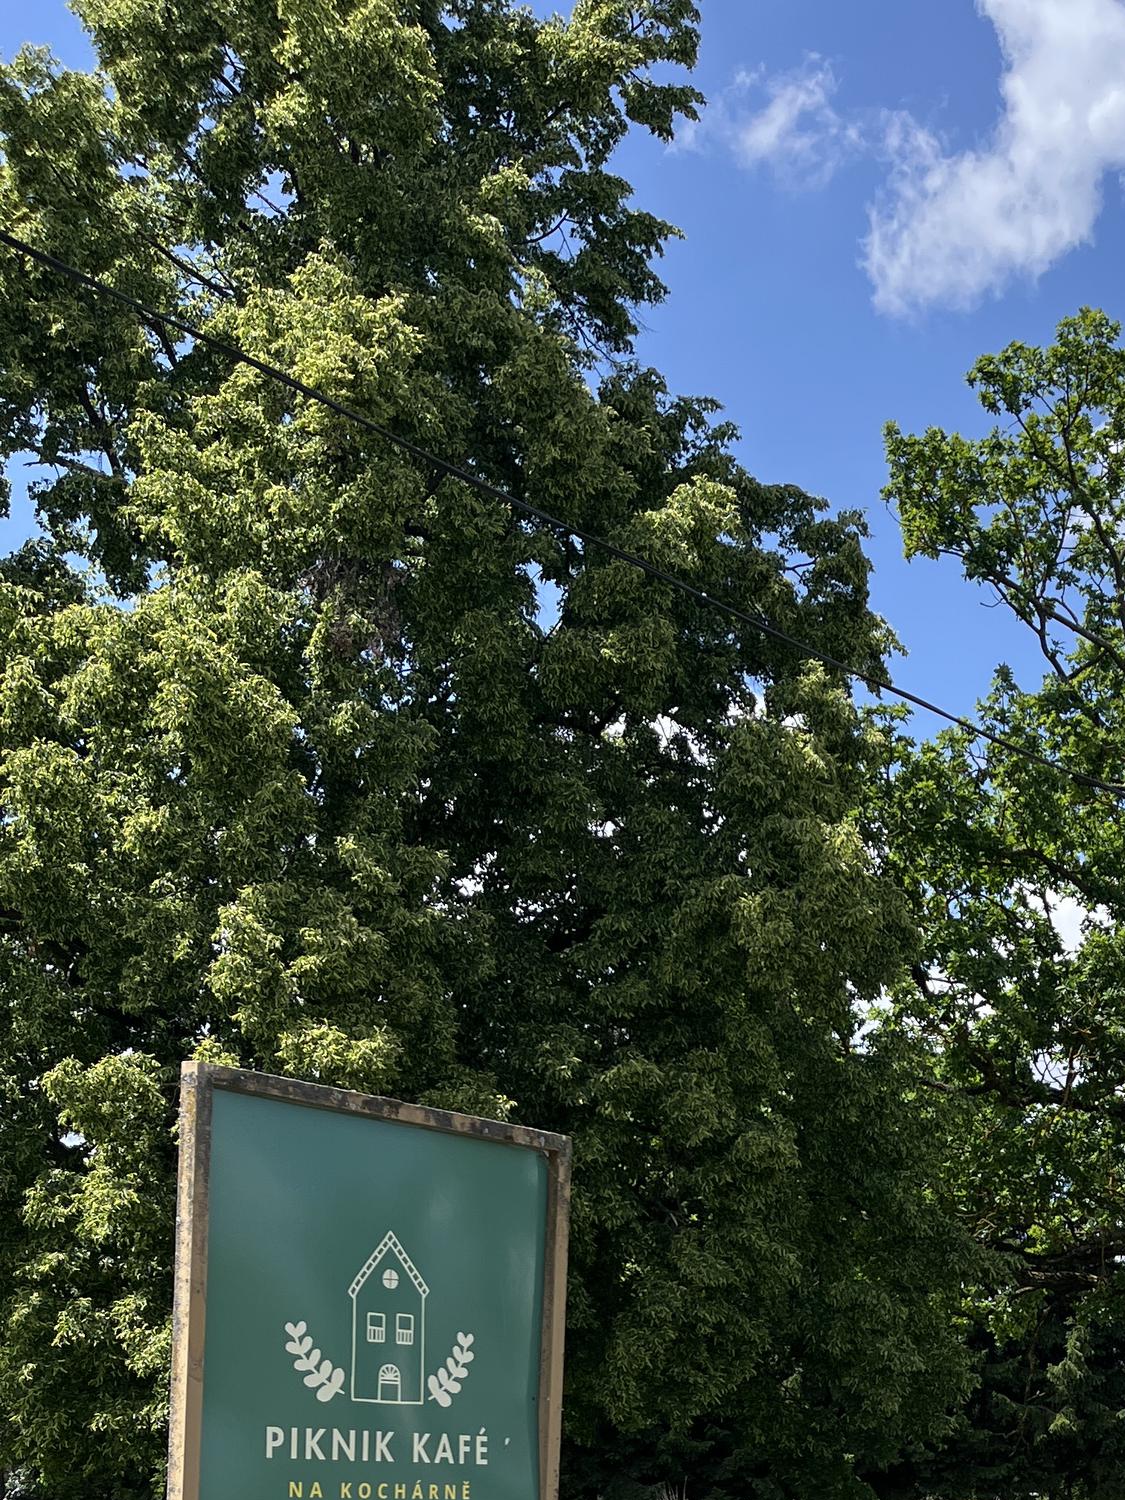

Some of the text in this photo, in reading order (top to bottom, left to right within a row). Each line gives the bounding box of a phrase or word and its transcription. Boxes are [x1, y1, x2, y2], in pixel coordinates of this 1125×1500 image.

[265, 1426, 489, 1465] PIKNIK KAFÉ
[288, 1480, 471, 1500] NA KOCHÁRNĚ
